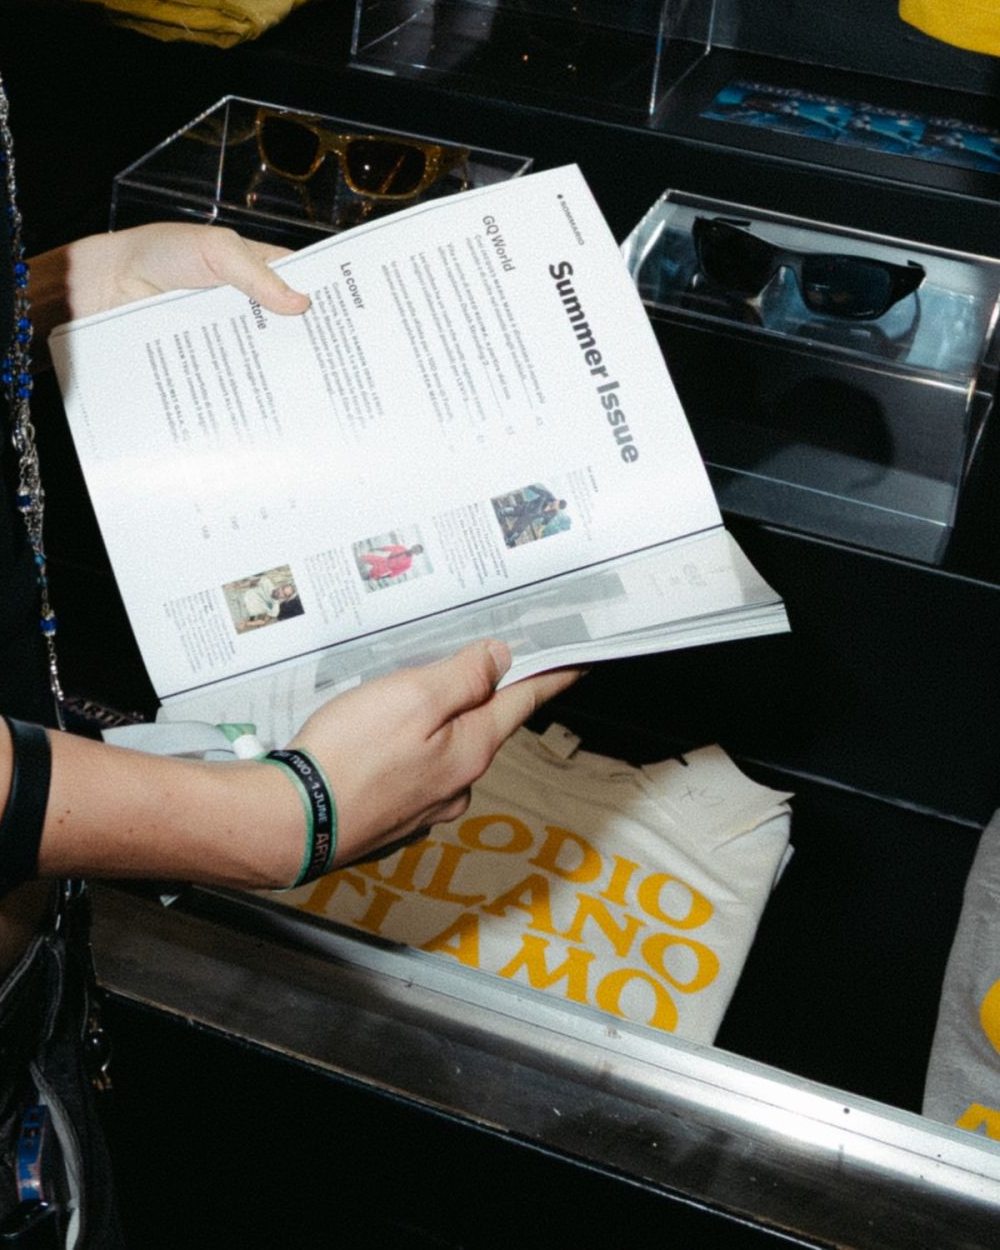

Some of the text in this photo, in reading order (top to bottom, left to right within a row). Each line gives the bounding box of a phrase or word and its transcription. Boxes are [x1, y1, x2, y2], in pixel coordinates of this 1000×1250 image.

[482, 215, 516, 273] GQ World
[560, 200, 585, 247] SOMMARIO
[340, 261, 365, 311] Le cover
[465, 288, 478, 311] HIDEO
[493, 277, 506, 301] MARIE
[502, 301, 514, 322] MAGE
[323, 315, 338, 343] Maverick
[460, 301, 473, 324] Death
[467, 323, 486, 360] Stranding
[549, 260, 639, 464] Summer Issue
[289, 755, 312, 775] TWO
[313, 791, 328, 823] JUNE
[459, 813, 714, 931] ODIO
[421, 908, 679, 1033] AMO
